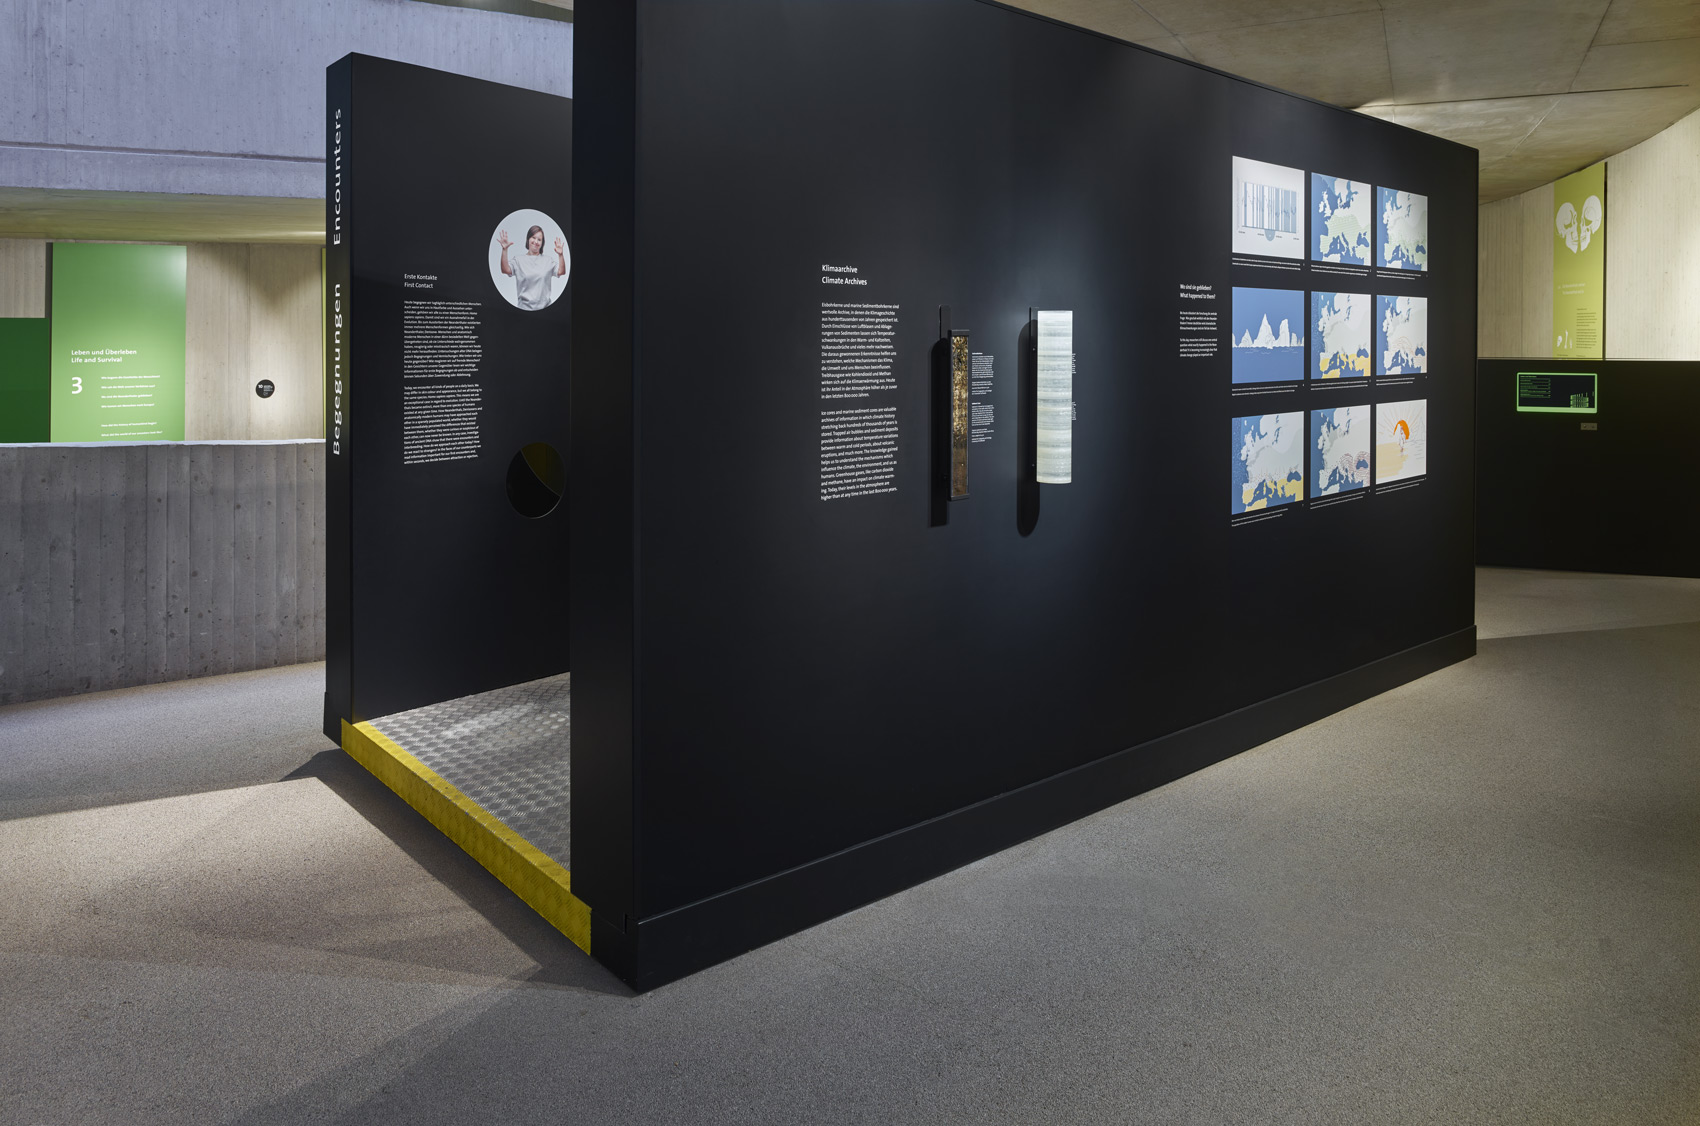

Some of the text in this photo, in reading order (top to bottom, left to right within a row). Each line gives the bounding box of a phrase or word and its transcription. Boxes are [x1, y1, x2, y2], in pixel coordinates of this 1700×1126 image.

[333, 108, 342, 246] Encounters
[822, 264, 858, 273] Klimaarchive
[822, 276, 844, 284] Climate
[333, 284, 342, 456] Begegnungen
[72, 377, 83, 394] 3
